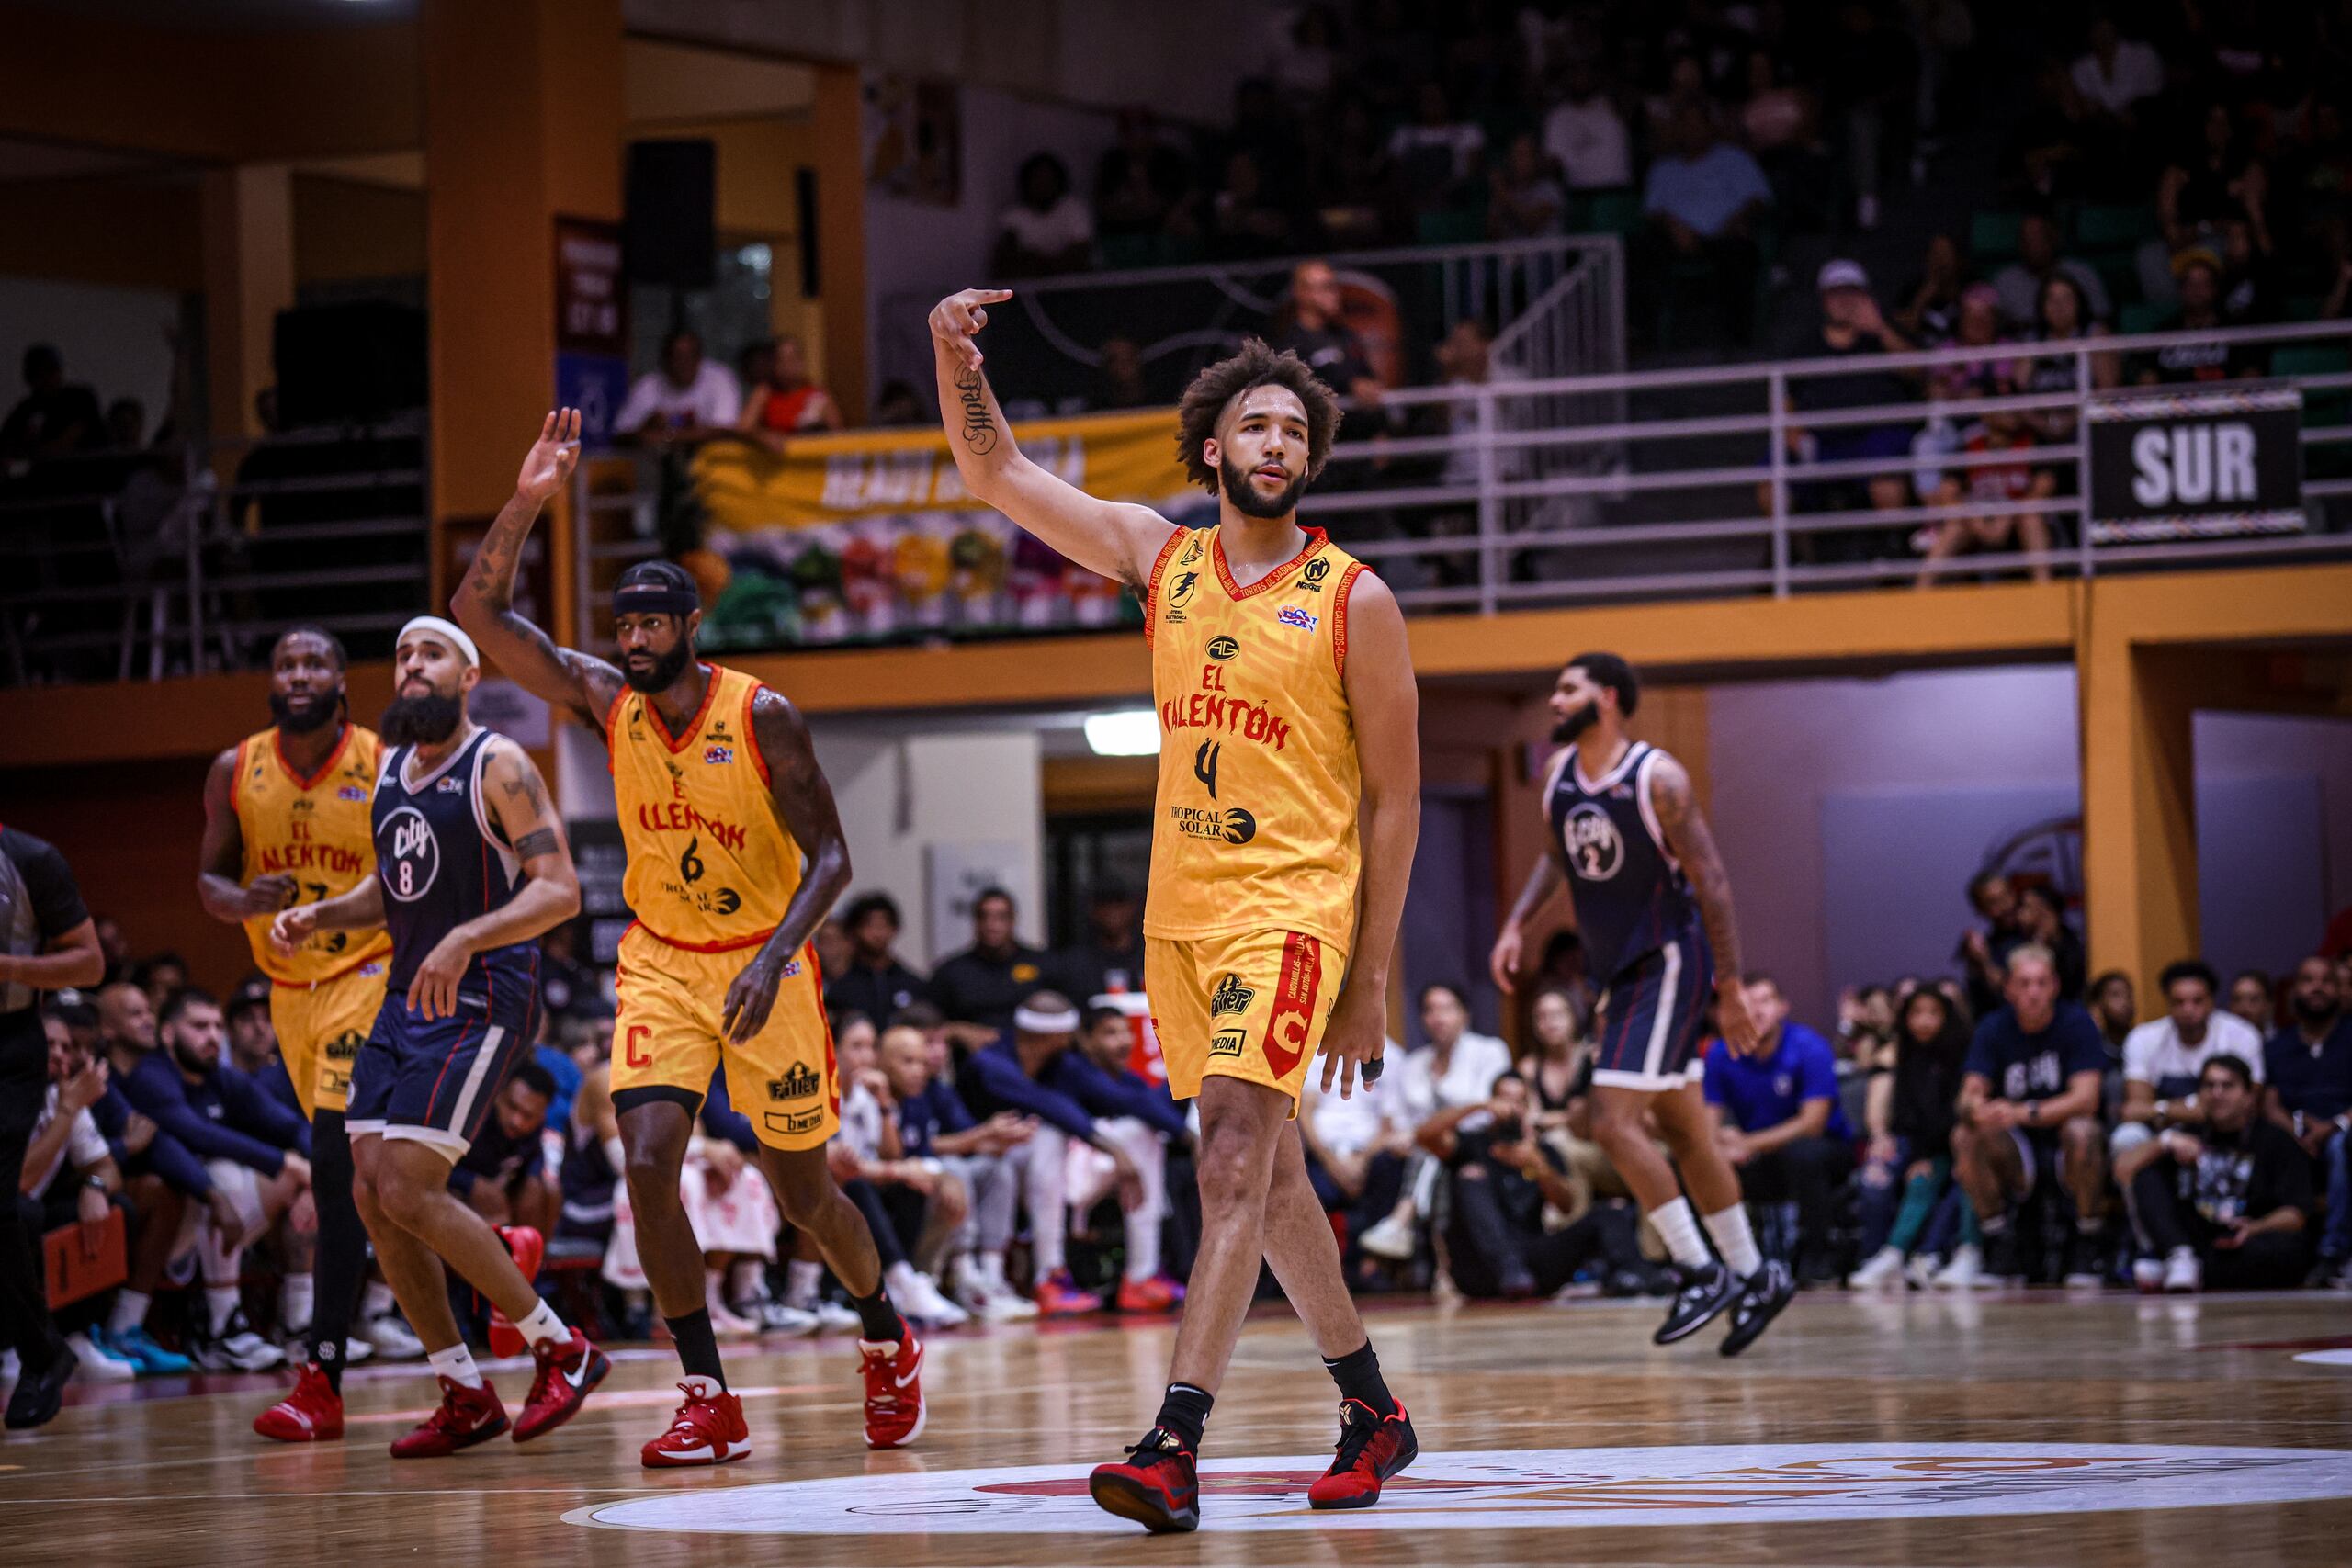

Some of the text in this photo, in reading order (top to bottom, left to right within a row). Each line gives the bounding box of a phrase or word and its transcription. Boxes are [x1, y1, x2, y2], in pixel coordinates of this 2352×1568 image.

[2131, 421, 2259, 509] SUR
[1241, 581, 1267, 598] TORRES
[1266, 576, 1275, 589] DE
[1203, 664, 1227, 692] EL
[1194, 737, 1222, 802] 4
[292, 820, 311, 840] EL
[1171, 806, 1222, 824] TROPICAL
[1179, 820, 1222, 837] SOLAR
[680, 835, 705, 884] 6
[1583, 843, 1602, 875] 2
[399, 860, 413, 896] 8
[627, 1025, 651, 1068] C
[770, 1077, 819, 1100] Filler
